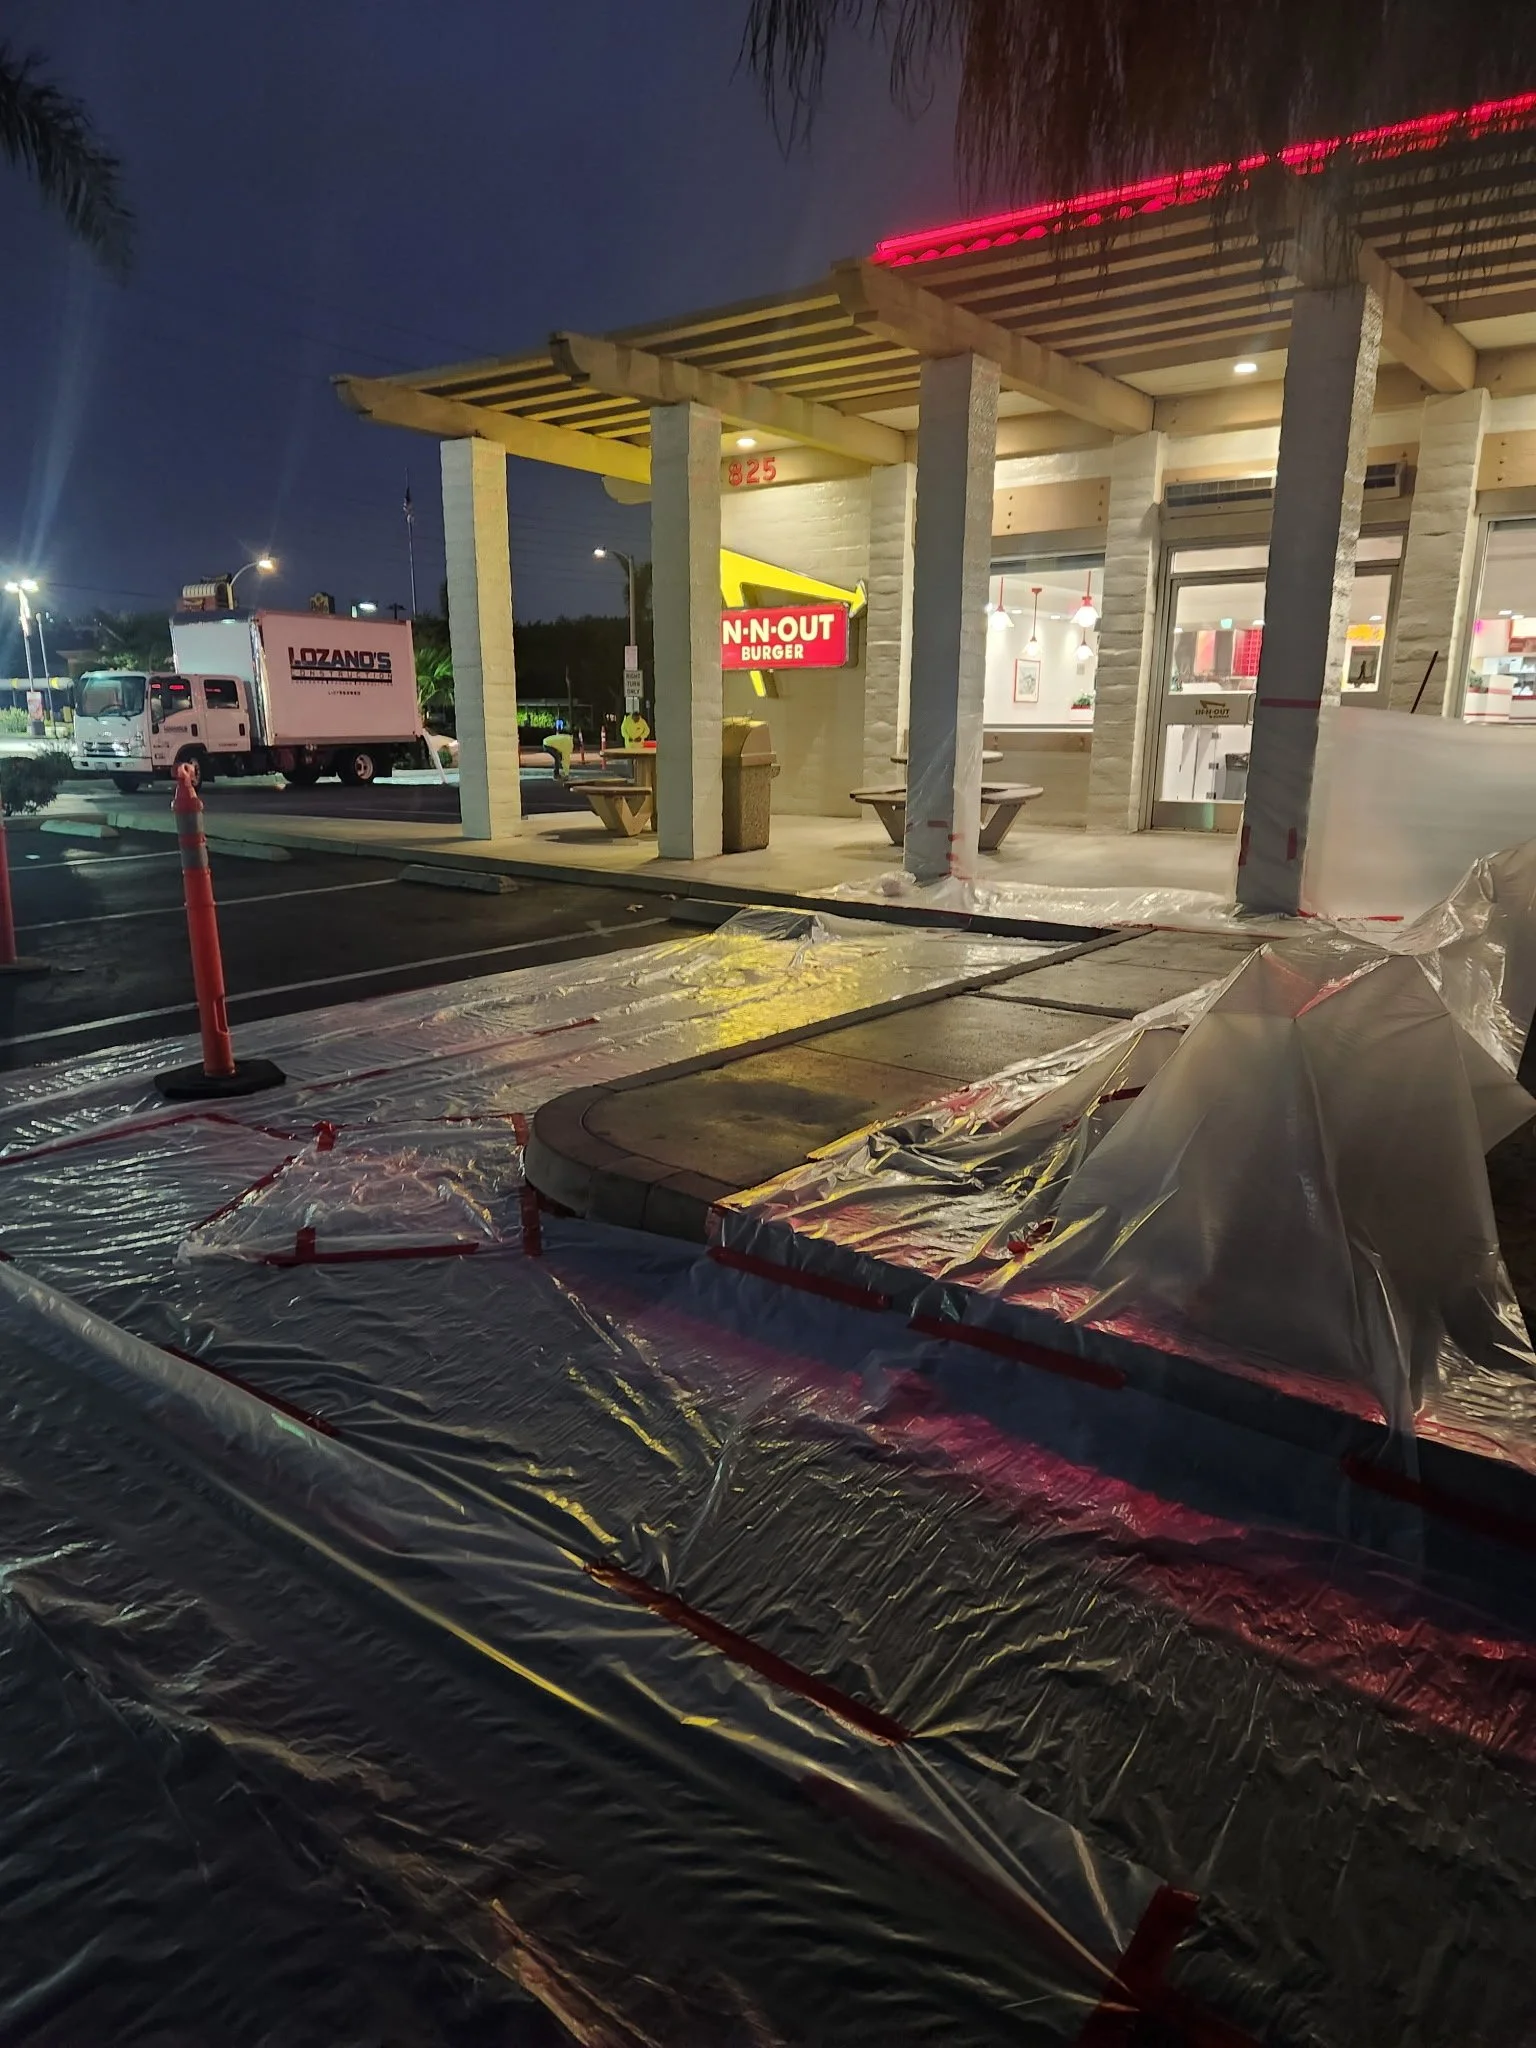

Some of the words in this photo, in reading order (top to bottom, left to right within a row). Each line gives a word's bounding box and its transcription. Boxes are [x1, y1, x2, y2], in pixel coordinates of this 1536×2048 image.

[728, 457, 776, 486] 825
[722, 613, 835, 645] N-N-OUT
[288, 647, 392, 670] LOZANO'S
[741, 643, 804, 661] BURGER
